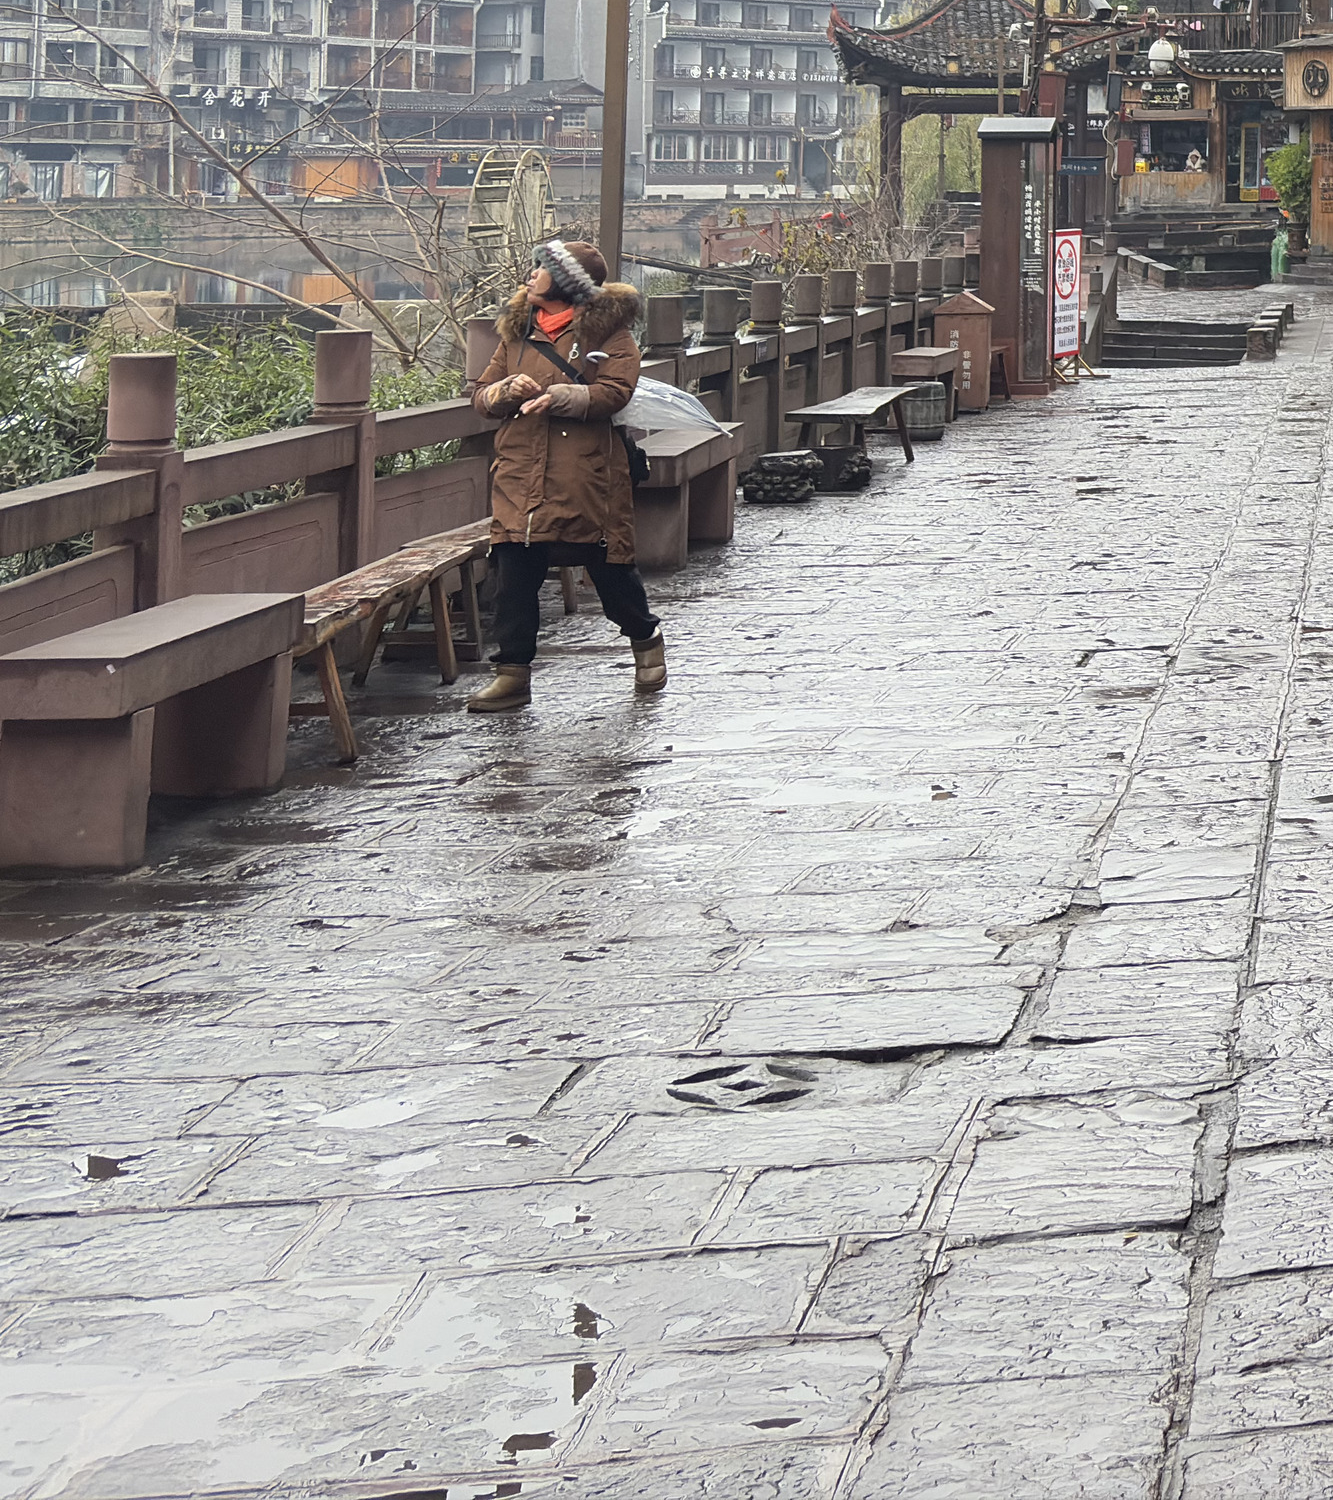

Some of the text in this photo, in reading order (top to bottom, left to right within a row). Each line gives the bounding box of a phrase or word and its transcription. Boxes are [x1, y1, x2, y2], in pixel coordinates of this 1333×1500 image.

[175, 87, 272, 108] 一舍花开
[961, 350, 972, 390] 非警勿用
